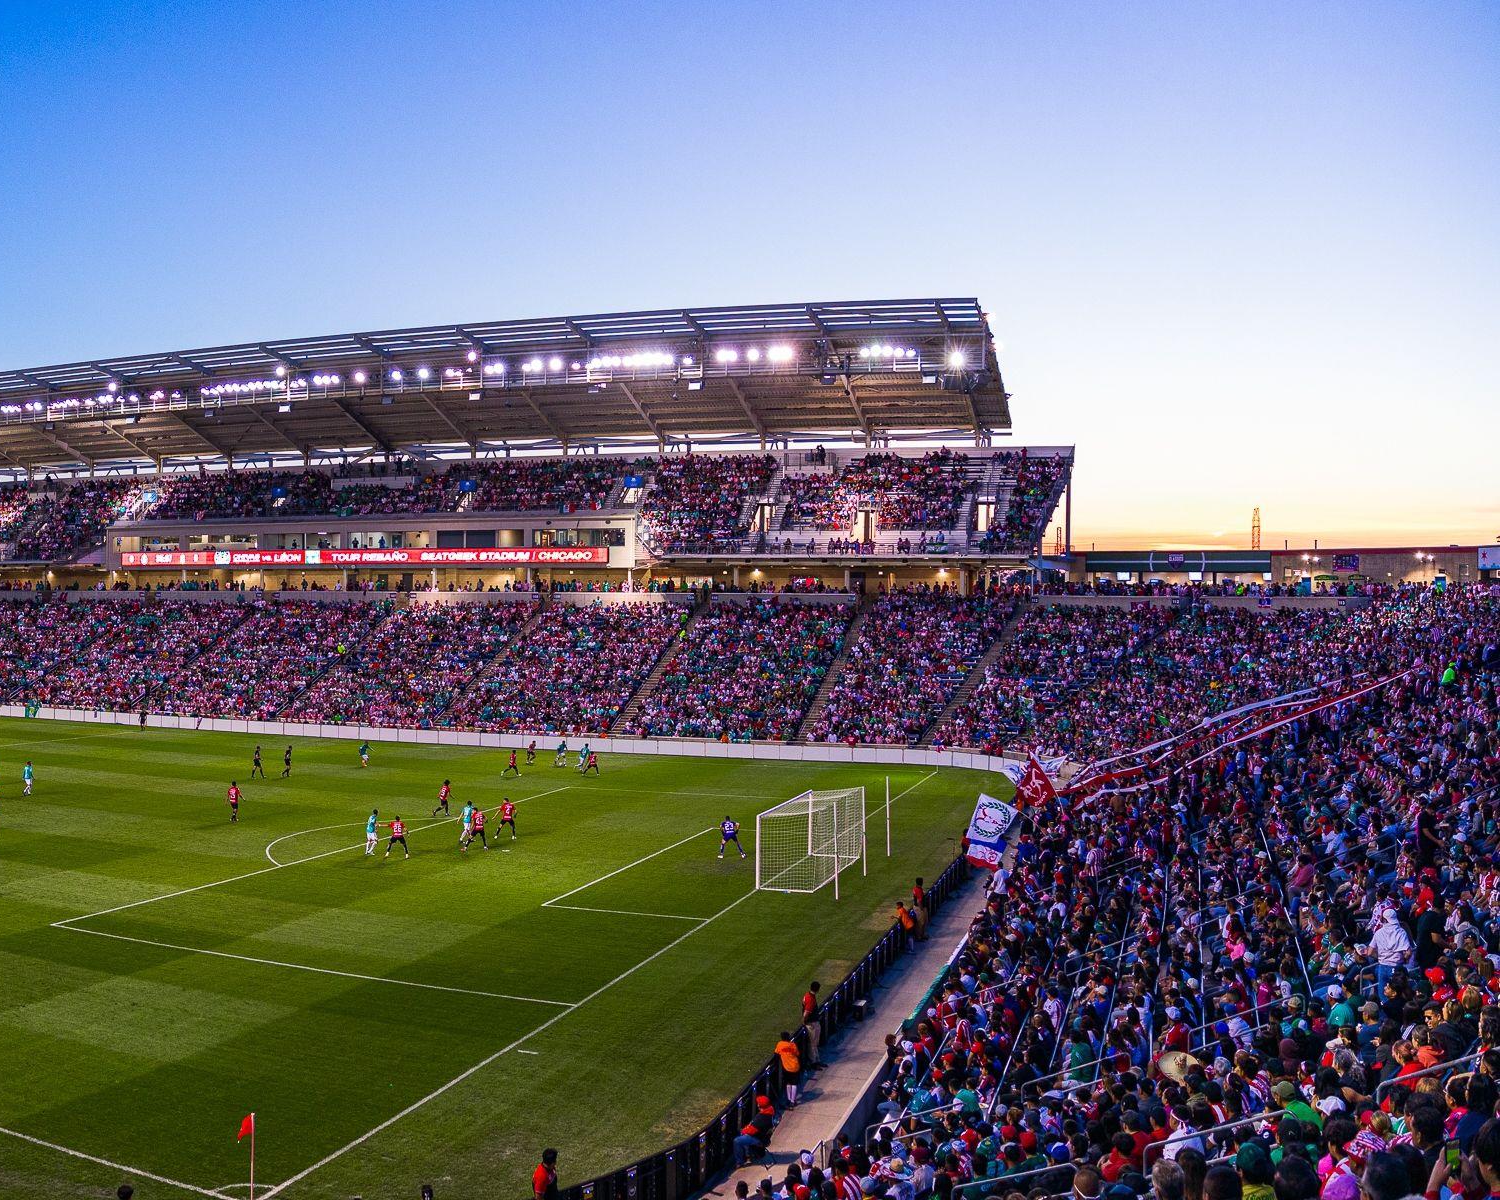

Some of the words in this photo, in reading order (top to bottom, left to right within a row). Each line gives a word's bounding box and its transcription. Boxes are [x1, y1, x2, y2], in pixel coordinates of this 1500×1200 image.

[332, 553, 360, 562] TOUR
[479, 552, 530, 561] STADIUM
[538, 551, 593, 560] CHICAGO
